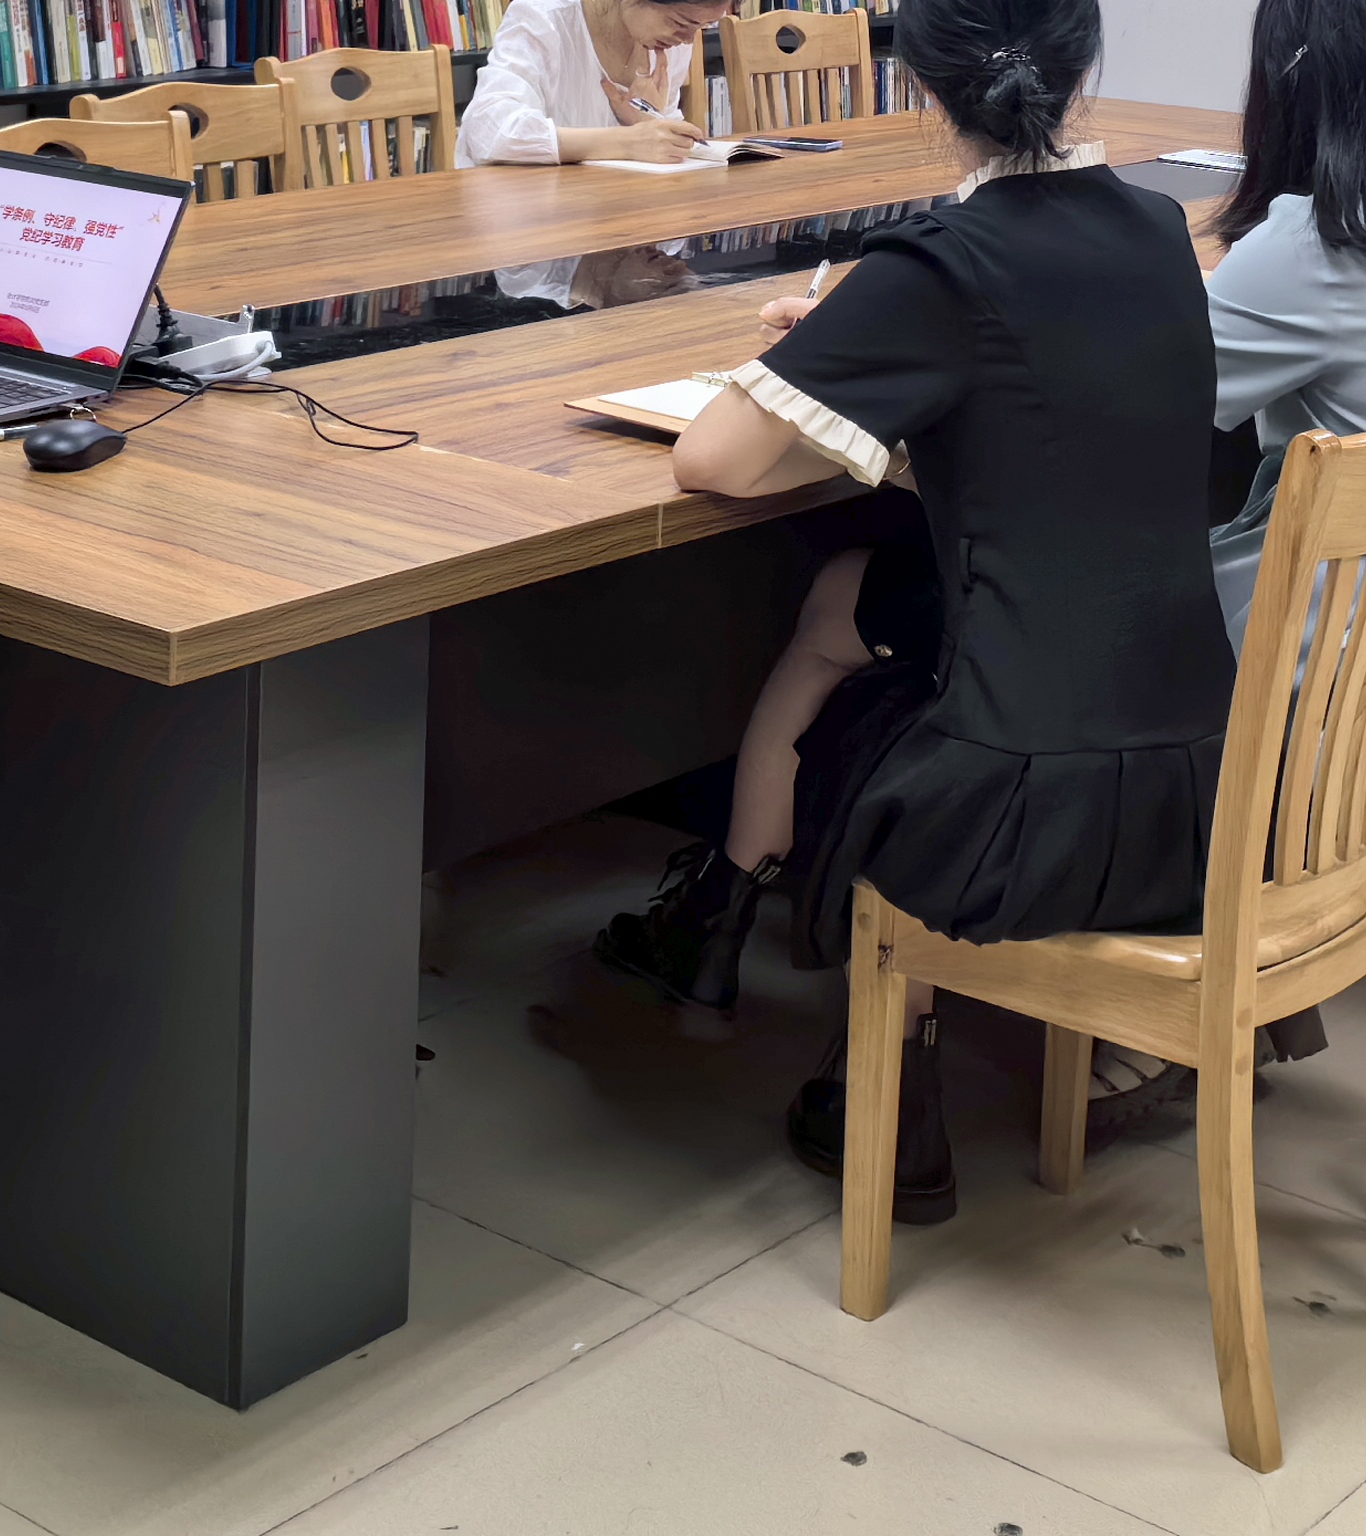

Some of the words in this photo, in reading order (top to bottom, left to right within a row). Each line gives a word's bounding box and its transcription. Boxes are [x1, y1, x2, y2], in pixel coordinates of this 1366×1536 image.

[19, 227, 86, 252] 党纪学习教育
